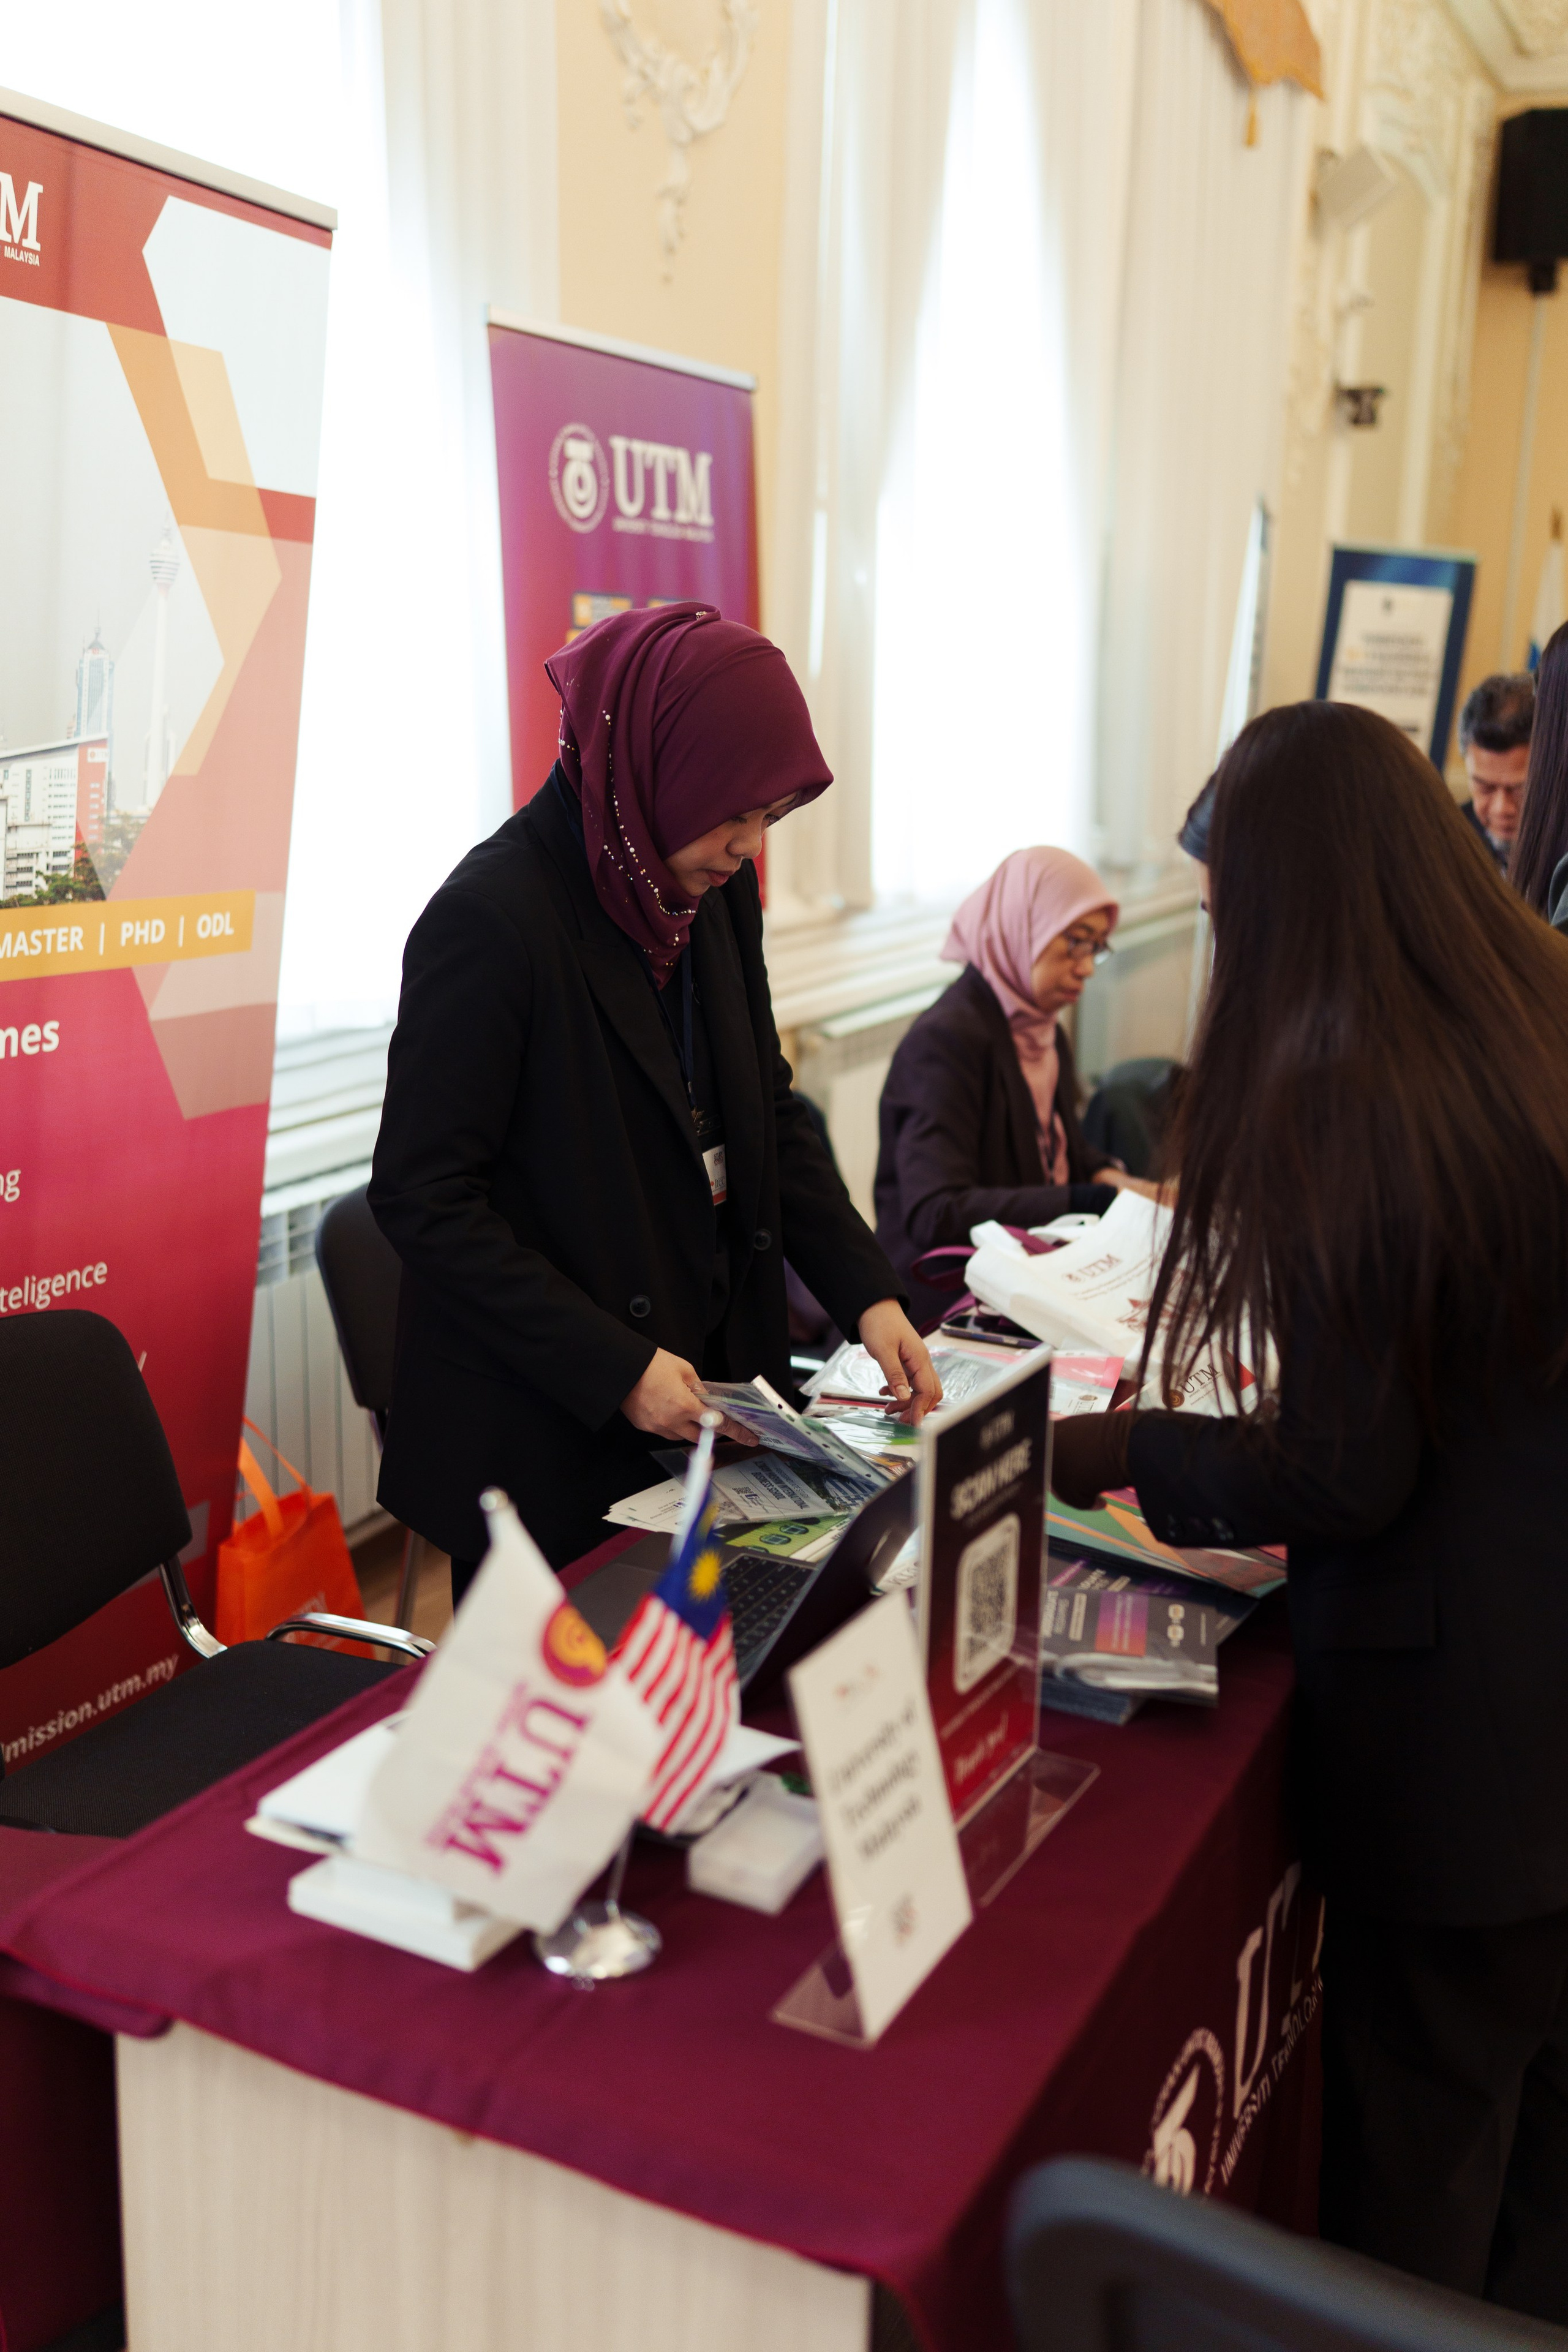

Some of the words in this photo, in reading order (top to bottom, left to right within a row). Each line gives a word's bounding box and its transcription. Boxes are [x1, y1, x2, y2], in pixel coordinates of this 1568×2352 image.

[4, 245, 40, 266] MALAYSIA
[609, 435, 714, 528] UTM
[121, 919, 165, 947] PHD
[197, 911, 234, 939] ODL
[1078, 1253, 1122, 1278] UTM
[1179, 1363, 1220, 1393] UTM
[447, 1698, 590, 1874] UTM
